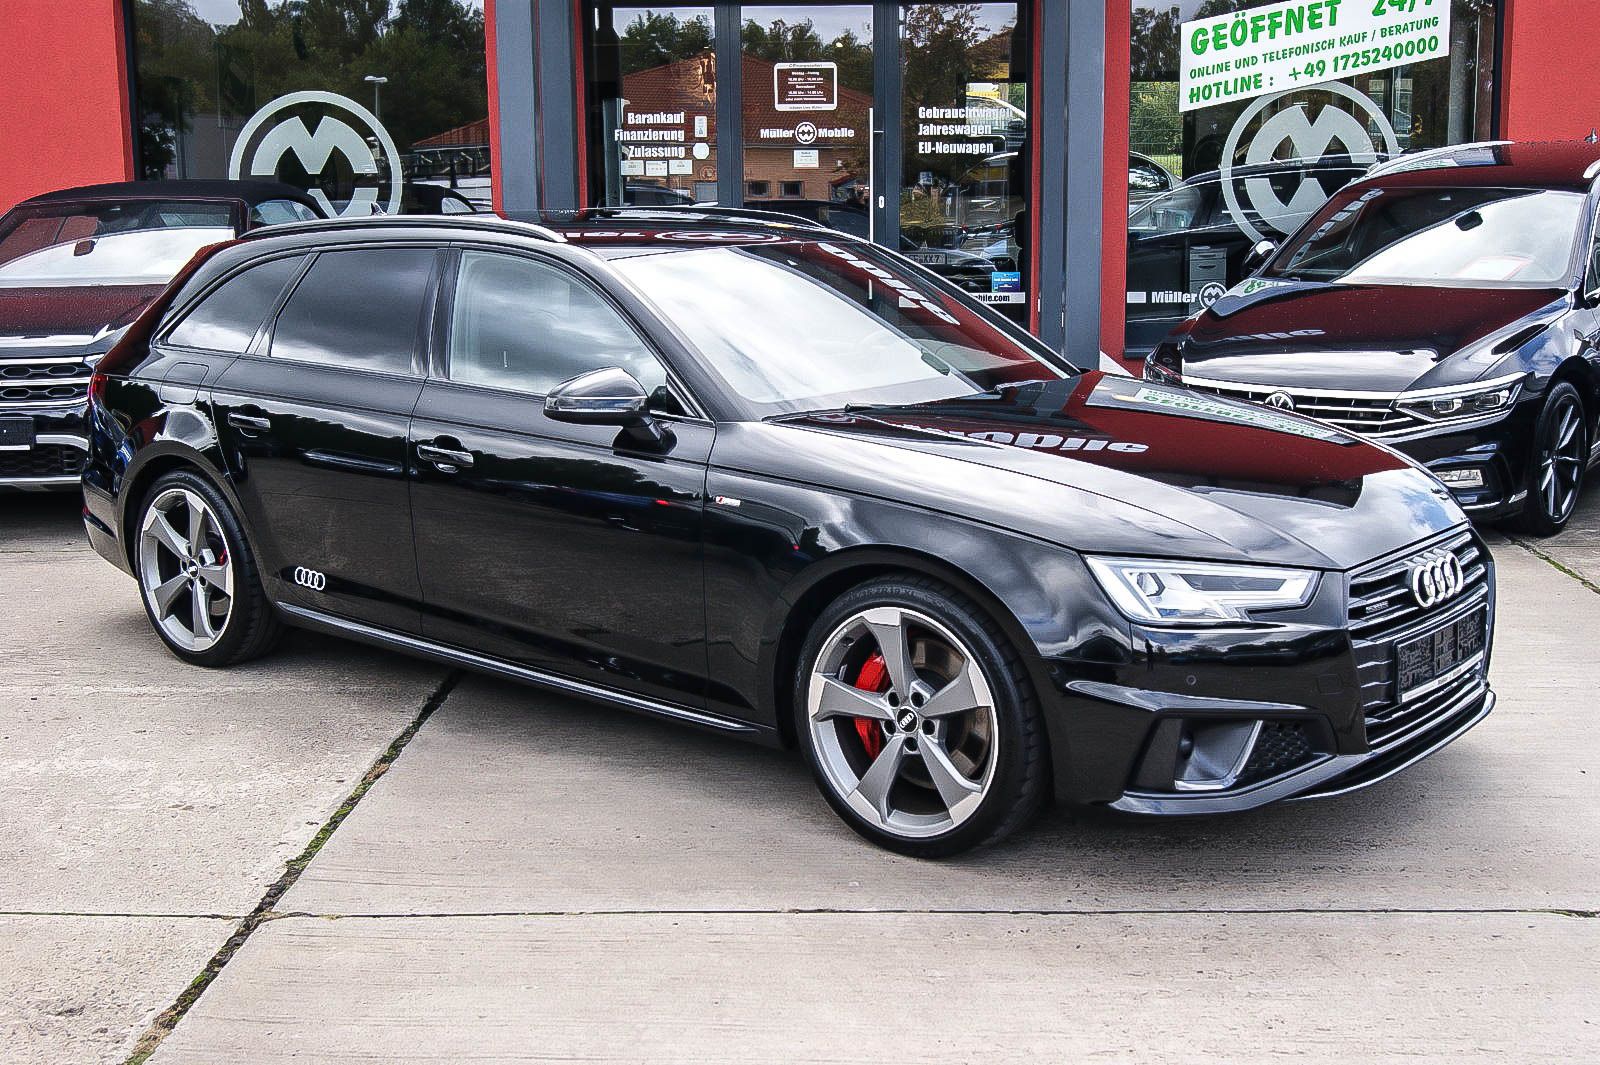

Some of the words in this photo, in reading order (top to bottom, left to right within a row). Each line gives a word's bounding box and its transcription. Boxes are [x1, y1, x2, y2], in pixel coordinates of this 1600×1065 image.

[1190, 0, 1342, 56] GEÖFFNET
[1189, 61, 1231, 80] ONLINE
[1234, 55, 1258, 70] UND
[1262, 38, 1335, 64] TELEFONISCH
[1339, 31, 1368, 48] KAUF
[1380, 16, 1439, 39] BERATUNG
[1188, 73, 1262, 104] HOTLINE
[1288, 59, 1326, 82] +49
[1332, 35, 1439, 73] 1725240000
[627, 111, 685, 125] Barankauf
[614, 128, 685, 142] Finanzierung
[760, 127, 795, 139] Müller
[817, 127, 855, 139] Mobile
[917, 123, 992, 137] Jahreswagen
[628, 145, 685, 159] Zulassung
[917, 141, 994, 155] EU-Neuwagen
[1151, 290, 1198, 304] Müller
